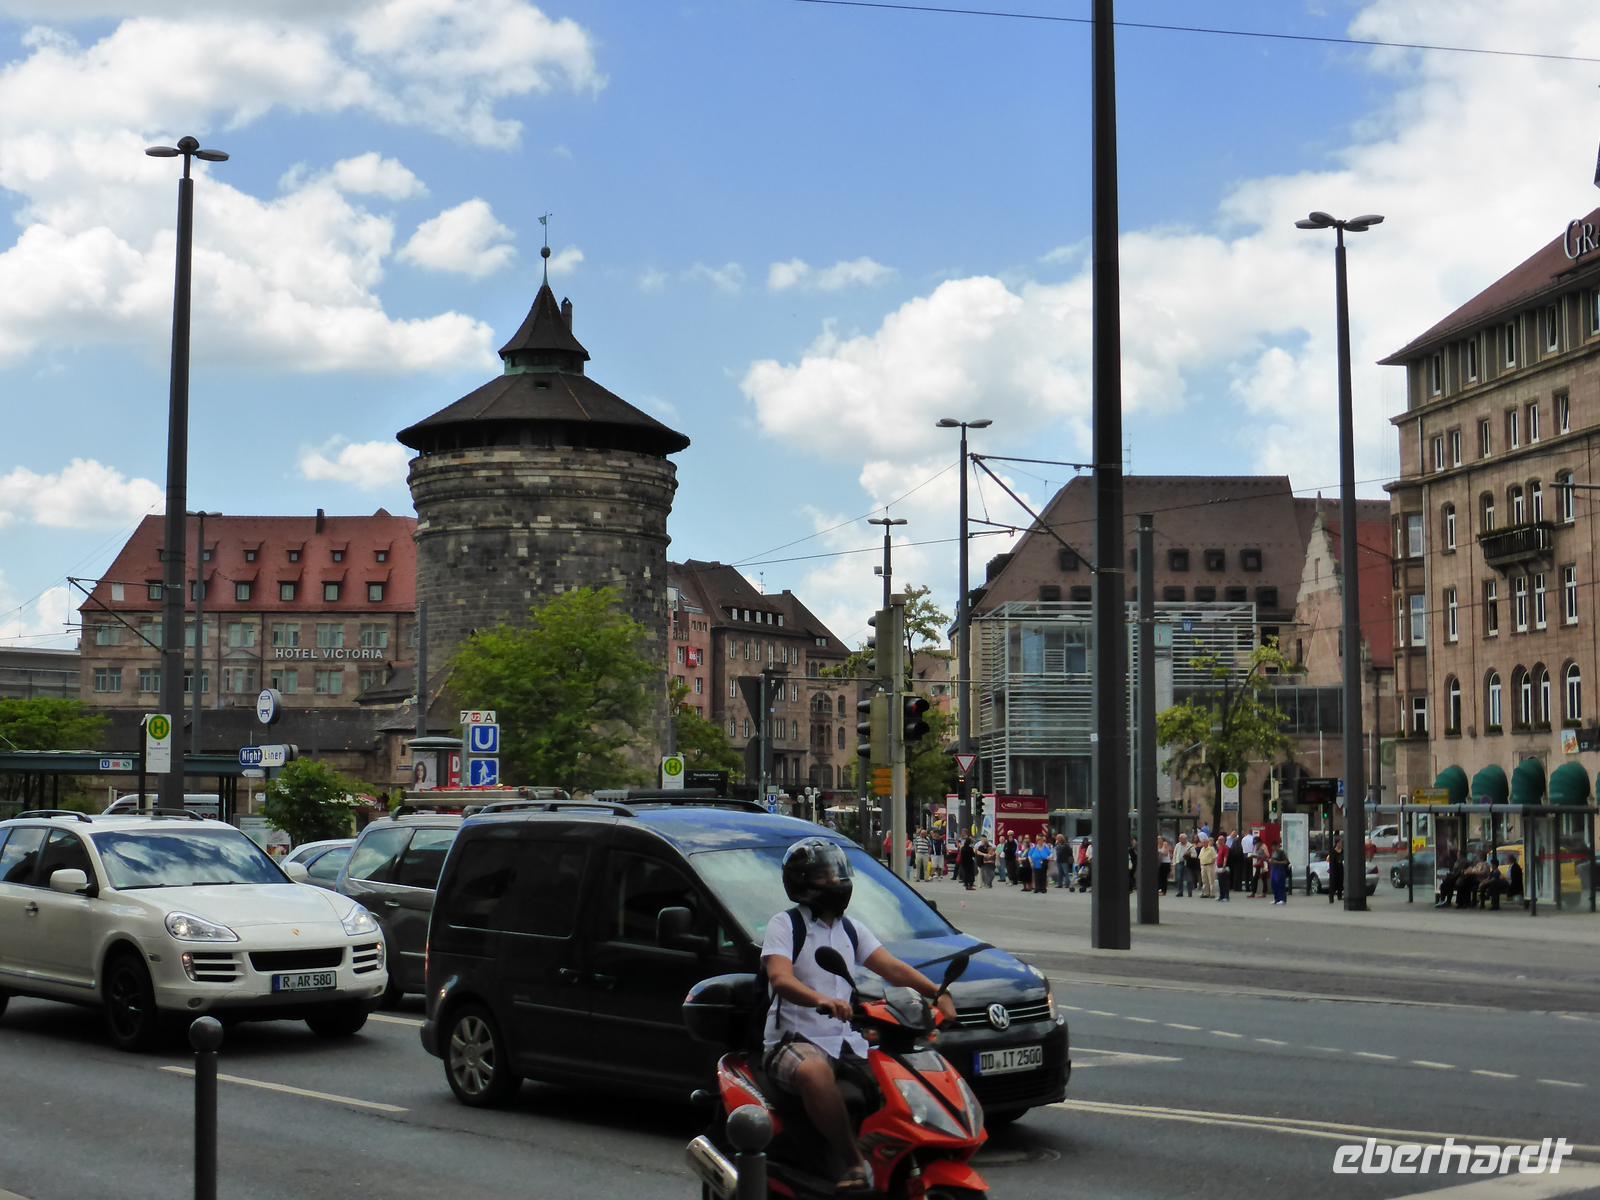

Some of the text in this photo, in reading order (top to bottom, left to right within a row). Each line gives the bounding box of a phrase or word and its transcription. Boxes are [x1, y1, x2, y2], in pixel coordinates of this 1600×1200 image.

[1564, 219, 1600, 259] GR
[275, 648, 383, 659] HOTEL VICTORIA
[461, 712, 494, 722] 7 U2 A
[154, 720, 165, 734] H
[475, 728, 494, 750] U
[242, 750, 282, 763] Night Liner
[102, 761, 109, 769] U
[282, 973, 332, 988] R AR 580
[981, 1053, 994, 1070] DD
[1003, 1051, 1014, 1068] IT
